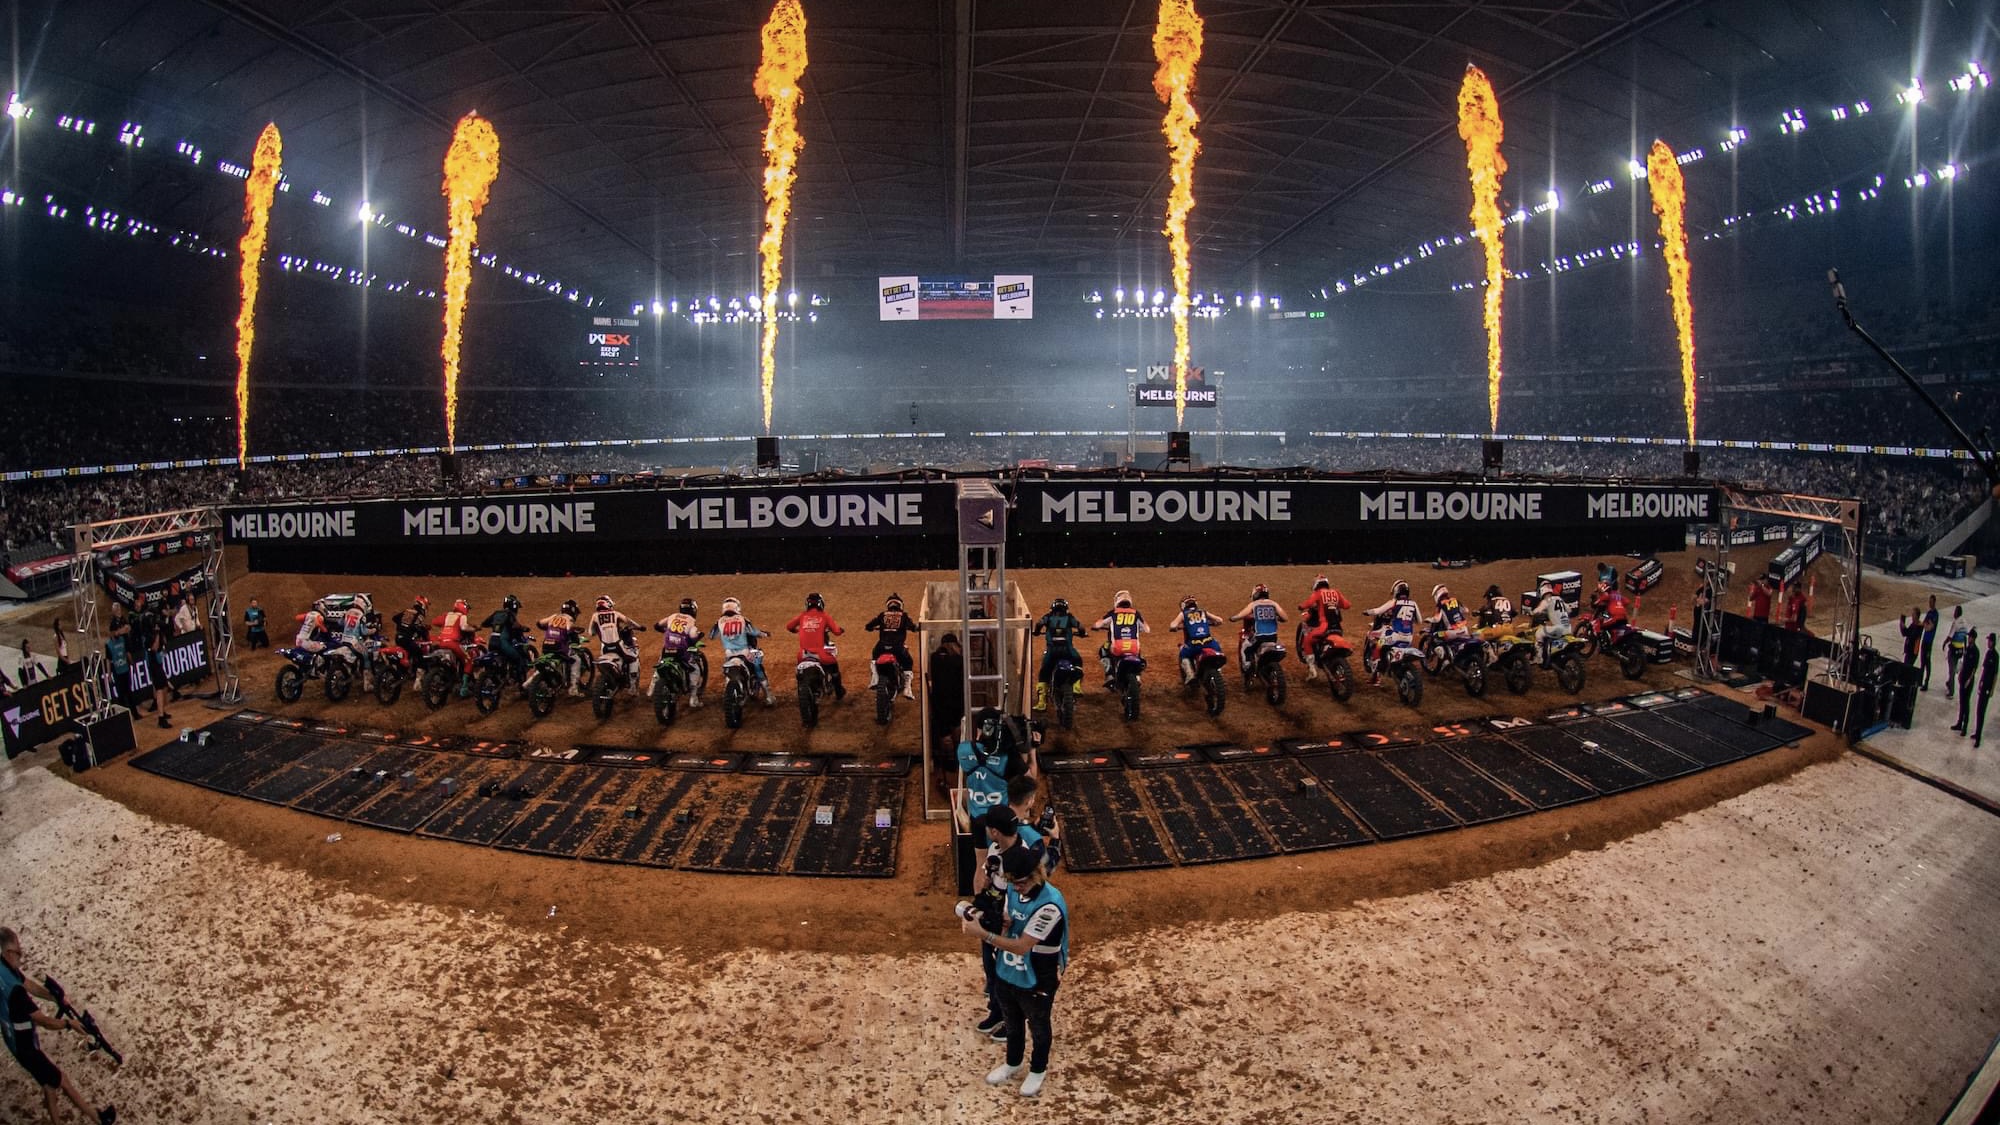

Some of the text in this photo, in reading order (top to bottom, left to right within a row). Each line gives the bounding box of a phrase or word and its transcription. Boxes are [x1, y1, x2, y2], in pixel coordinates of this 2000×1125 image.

[668, 494, 922, 529] MELBOURNE
[1042, 491, 1290, 522] MELBOURNE
[1361, 492, 1541, 520] MELBOURNE
[1588, 494, 1708, 518] MELBOURNE
[232, 513, 355, 537] MELBOURNE
[404, 503, 595, 535] MELBOURNE
[1562, 580, 1581, 588] boost
[1397, 607, 1413, 620] 45
[1495, 600, 1511, 612] 40
[670, 619, 685, 632] 66
[1116, 613, 1135, 625] 910
[41, 687, 72, 726] GET
[975, 771, 987, 780] TV
